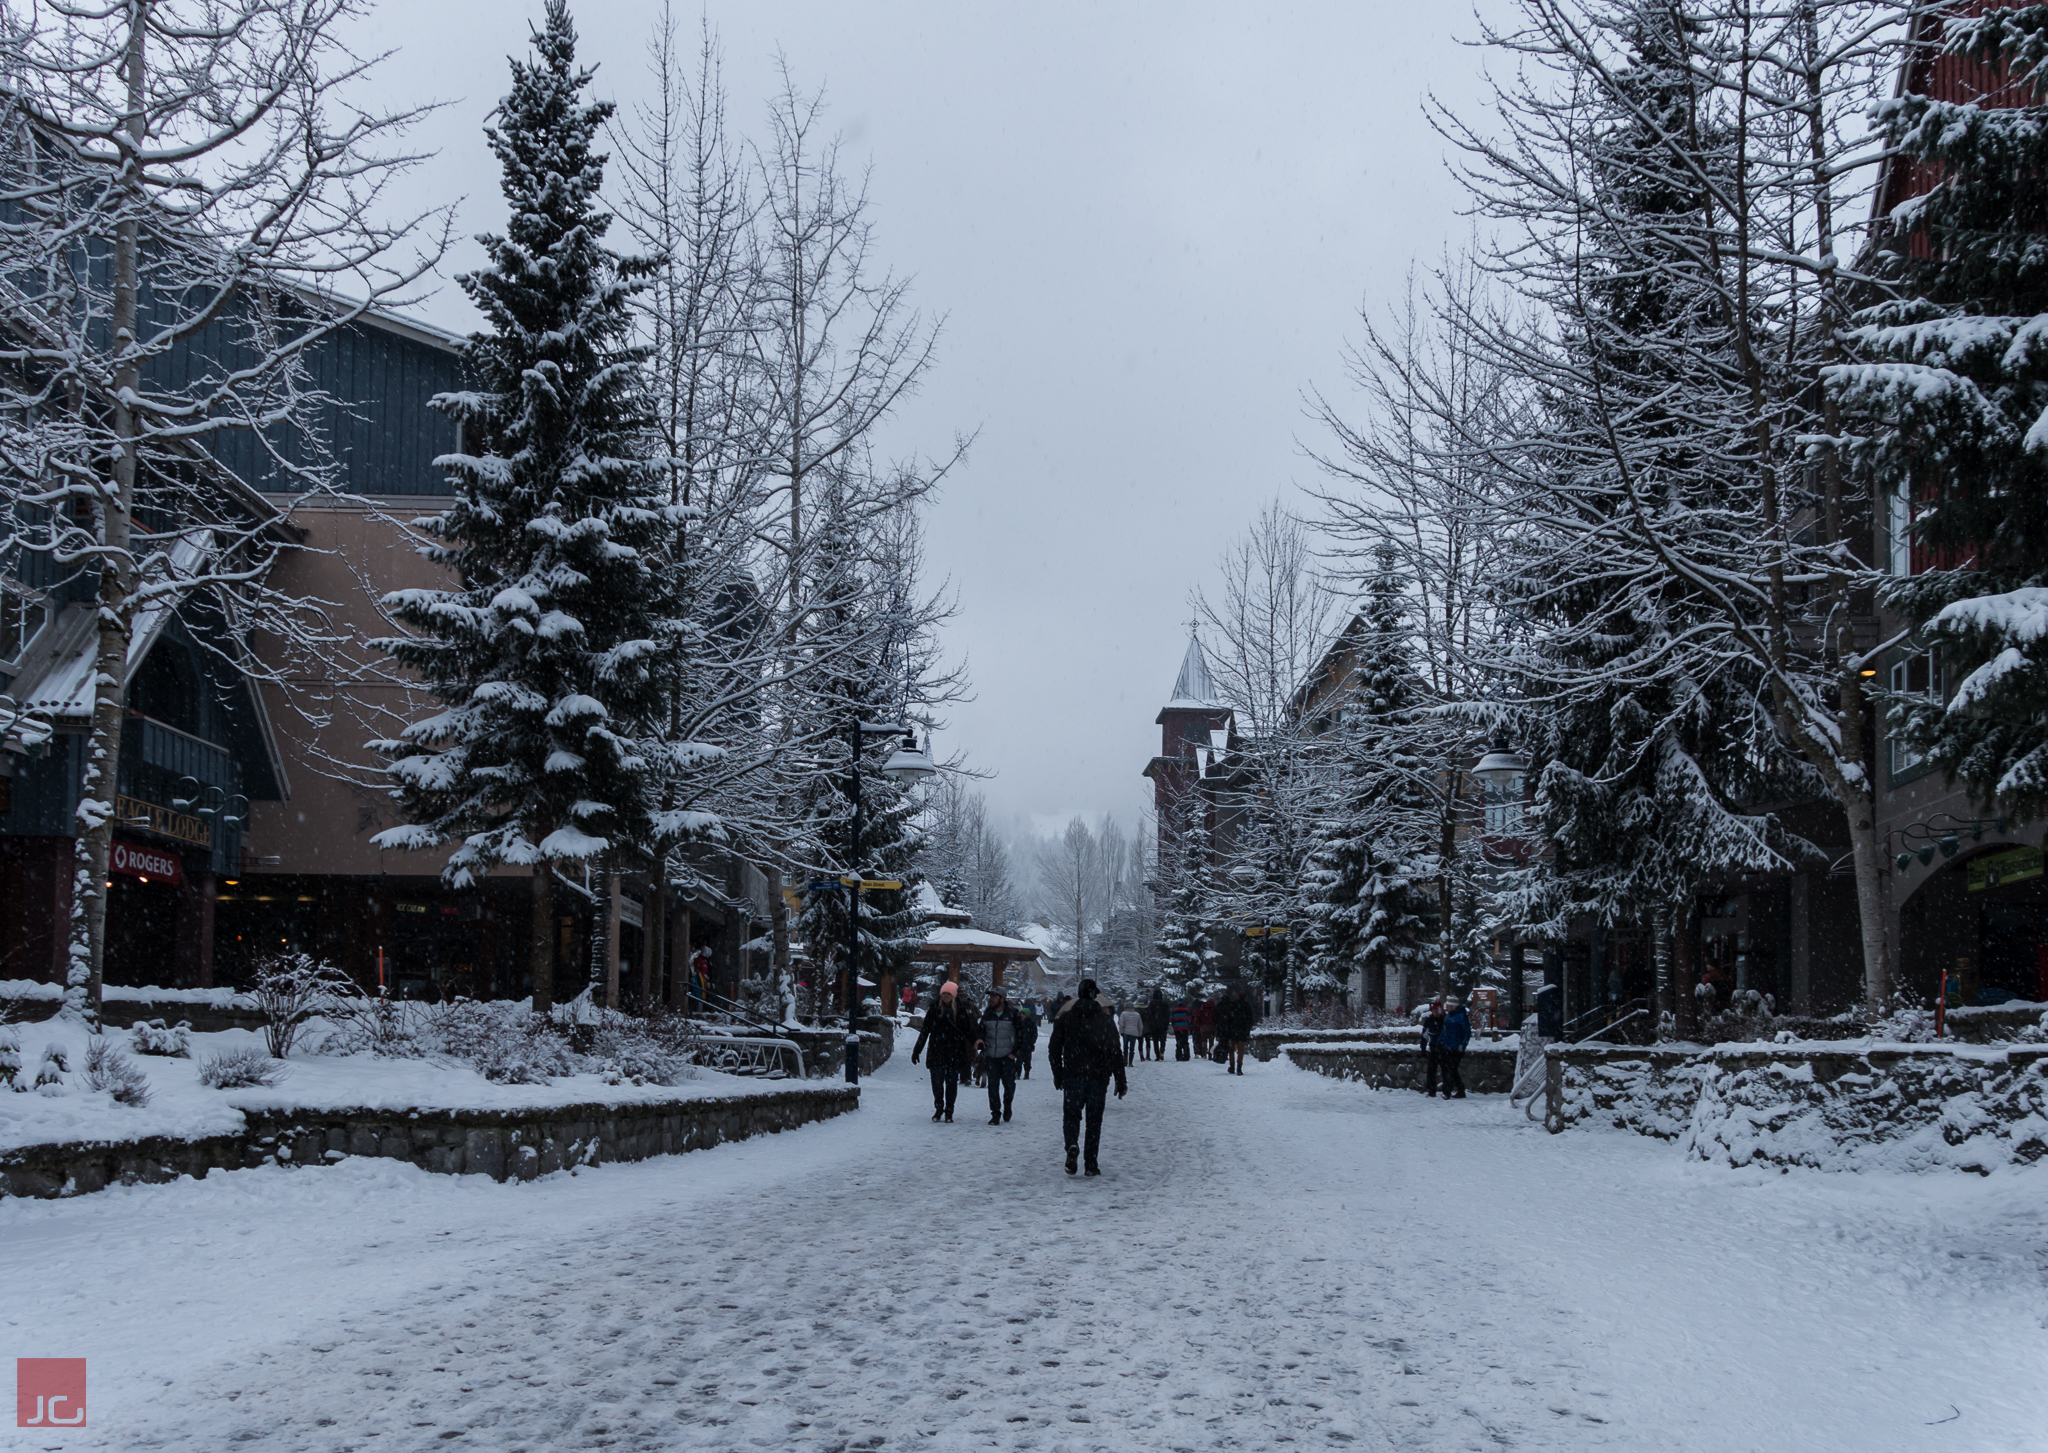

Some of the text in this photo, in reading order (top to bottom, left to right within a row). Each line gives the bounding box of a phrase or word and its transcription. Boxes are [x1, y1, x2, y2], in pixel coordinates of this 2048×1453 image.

[115, 796, 211, 843] EAGLE LODGE
[129, 851, 174, 877] ROGERS
[396, 903, 426, 913] ICE CREAM
